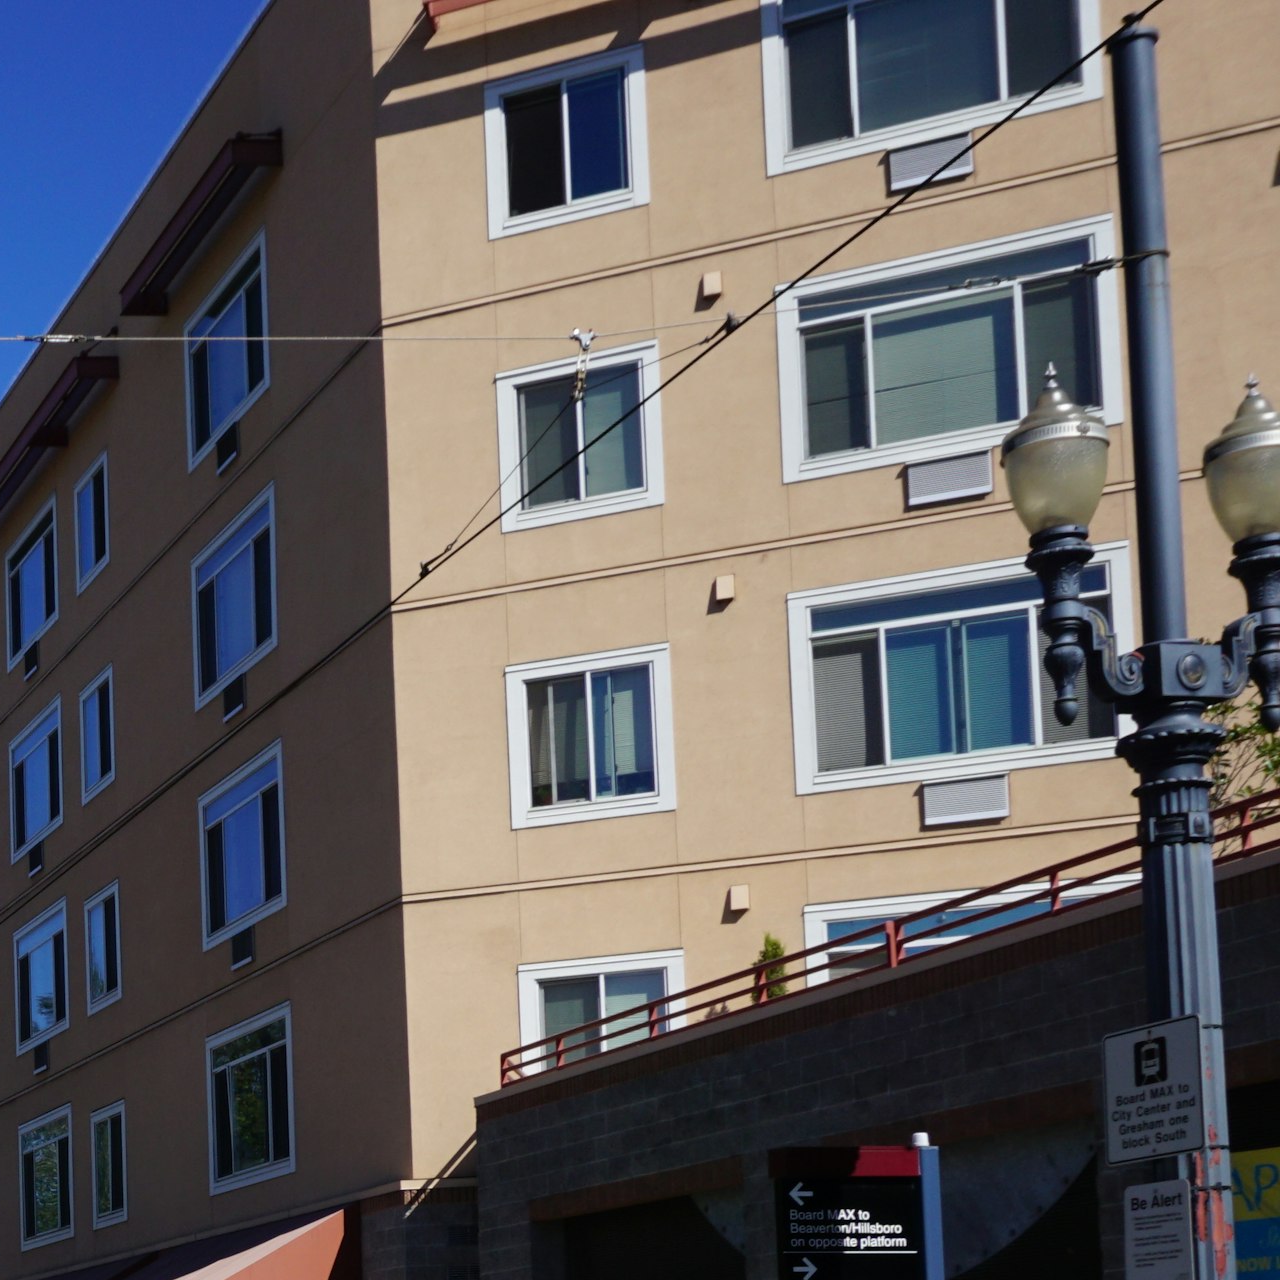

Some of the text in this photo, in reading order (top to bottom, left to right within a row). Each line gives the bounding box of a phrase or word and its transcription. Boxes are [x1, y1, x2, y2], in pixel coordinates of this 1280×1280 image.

[1115, 1083, 1190, 1107] Board MAX to
[1111, 1096, 1196, 1122] City Center and
[1119, 1114, 1190, 1136] Gresham one
[1122, 1130, 1187, 1149] block South
[1130, 1193, 1183, 1211] Be Alert
[789, 1209, 871, 1221] Board MAX to
[790, 1222, 903, 1234] Beaverton/Hillsboro
[790, 1235, 907, 1249] on opposite platform
